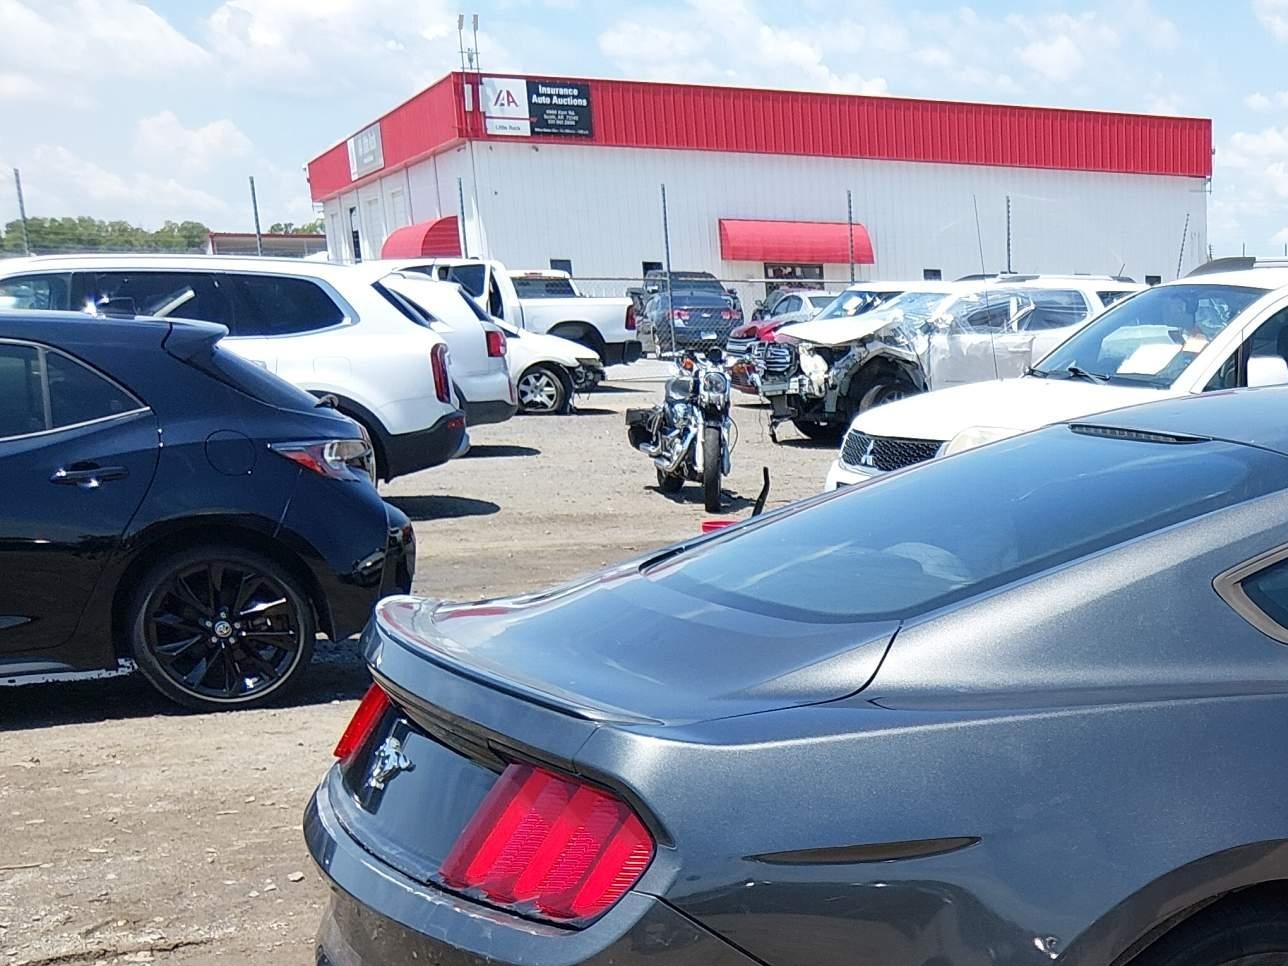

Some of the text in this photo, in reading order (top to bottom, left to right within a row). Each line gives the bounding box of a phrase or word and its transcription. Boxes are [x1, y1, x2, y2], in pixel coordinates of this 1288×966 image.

[538, 85, 578, 96] Insurance
[532, 94, 588, 107] Auto Auctions
